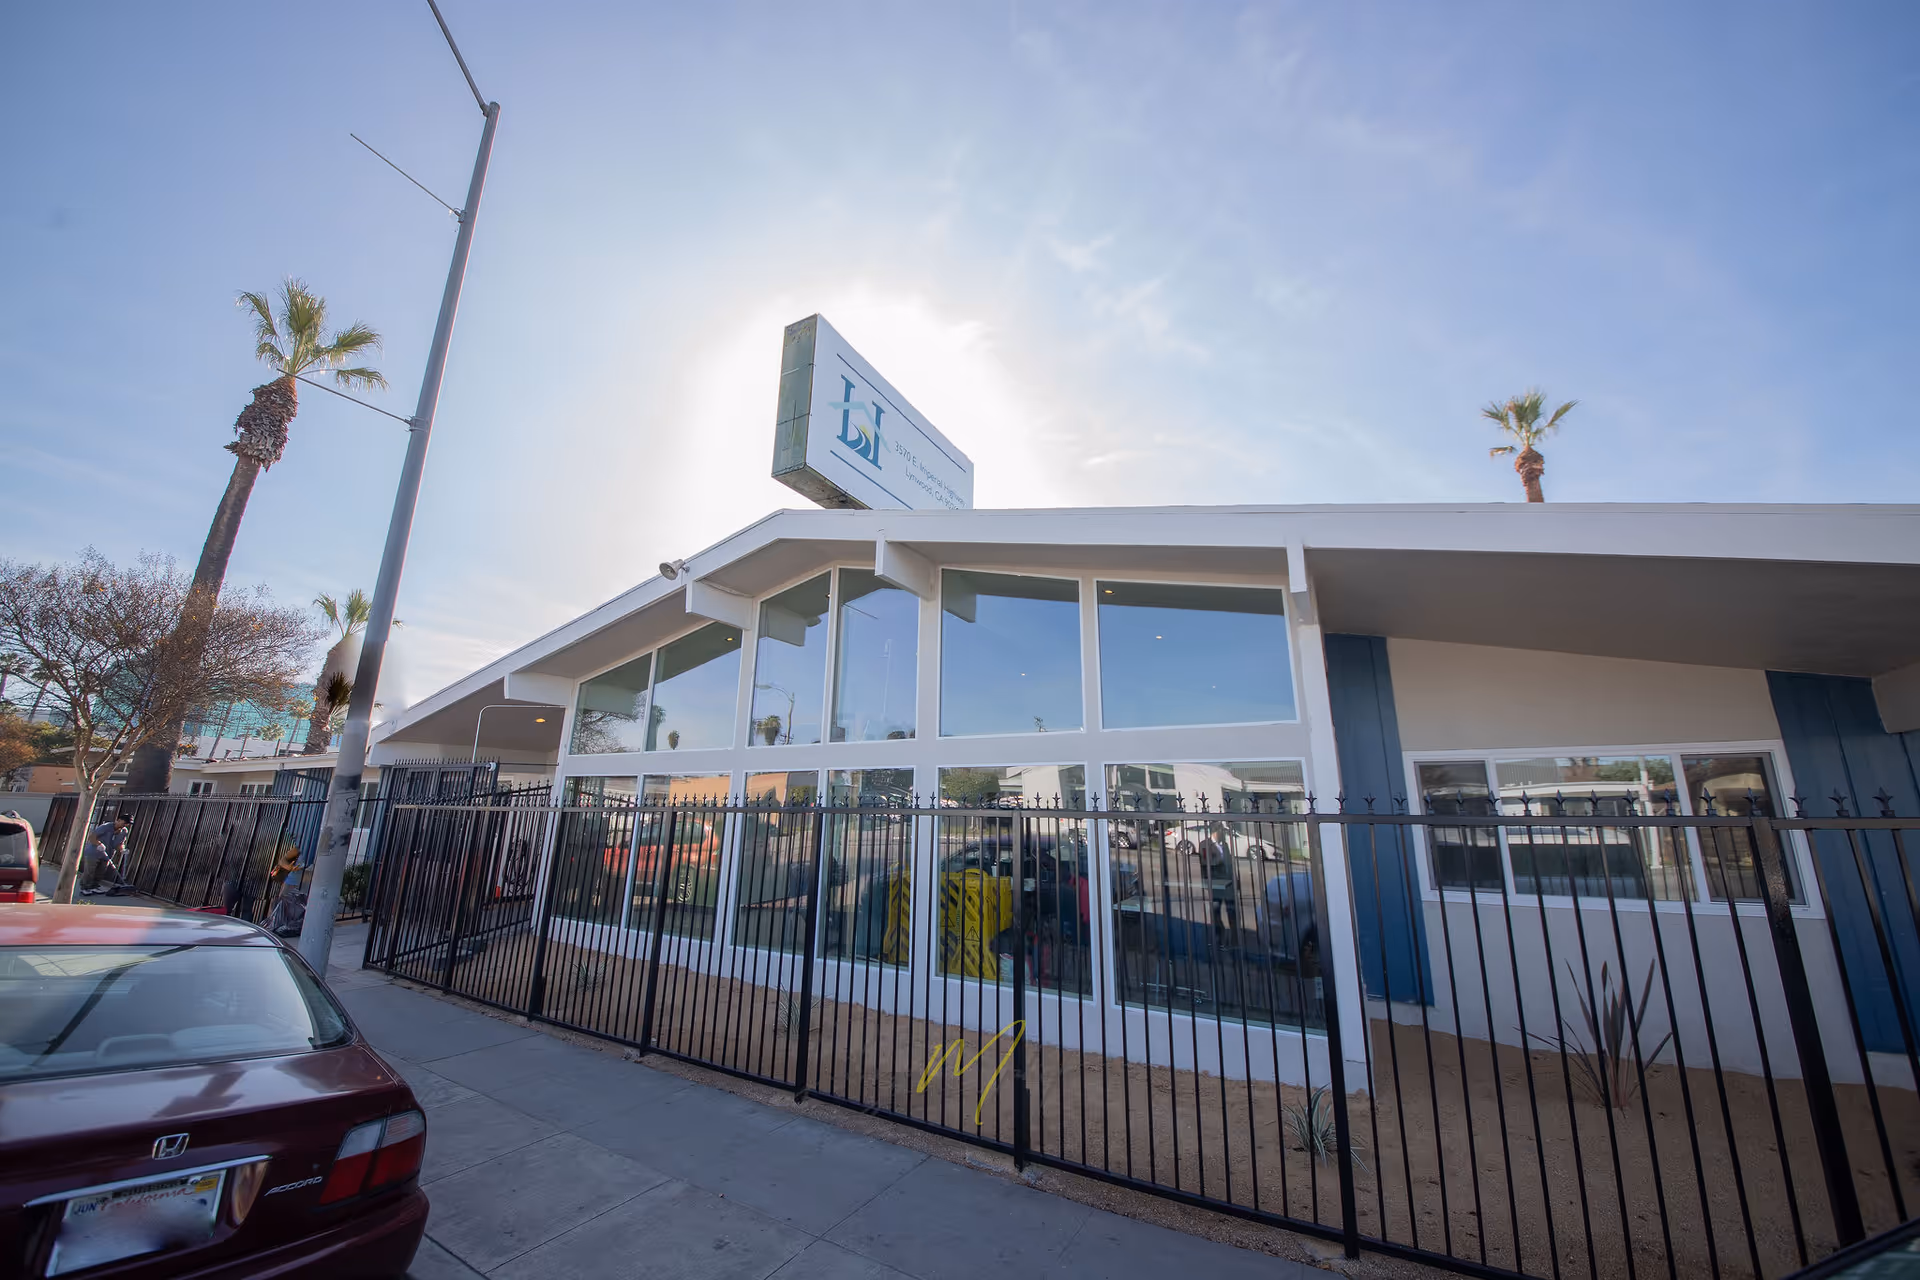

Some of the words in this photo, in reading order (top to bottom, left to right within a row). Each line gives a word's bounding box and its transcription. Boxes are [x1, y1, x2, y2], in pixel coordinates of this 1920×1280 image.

[895, 440, 911, 462] 3570
[912, 455, 919, 468] E.
[935, 490, 944, 503] CA
[263, 1176, 323, 1197] ACCORD
[74, 1202, 97, 1215] JUN
